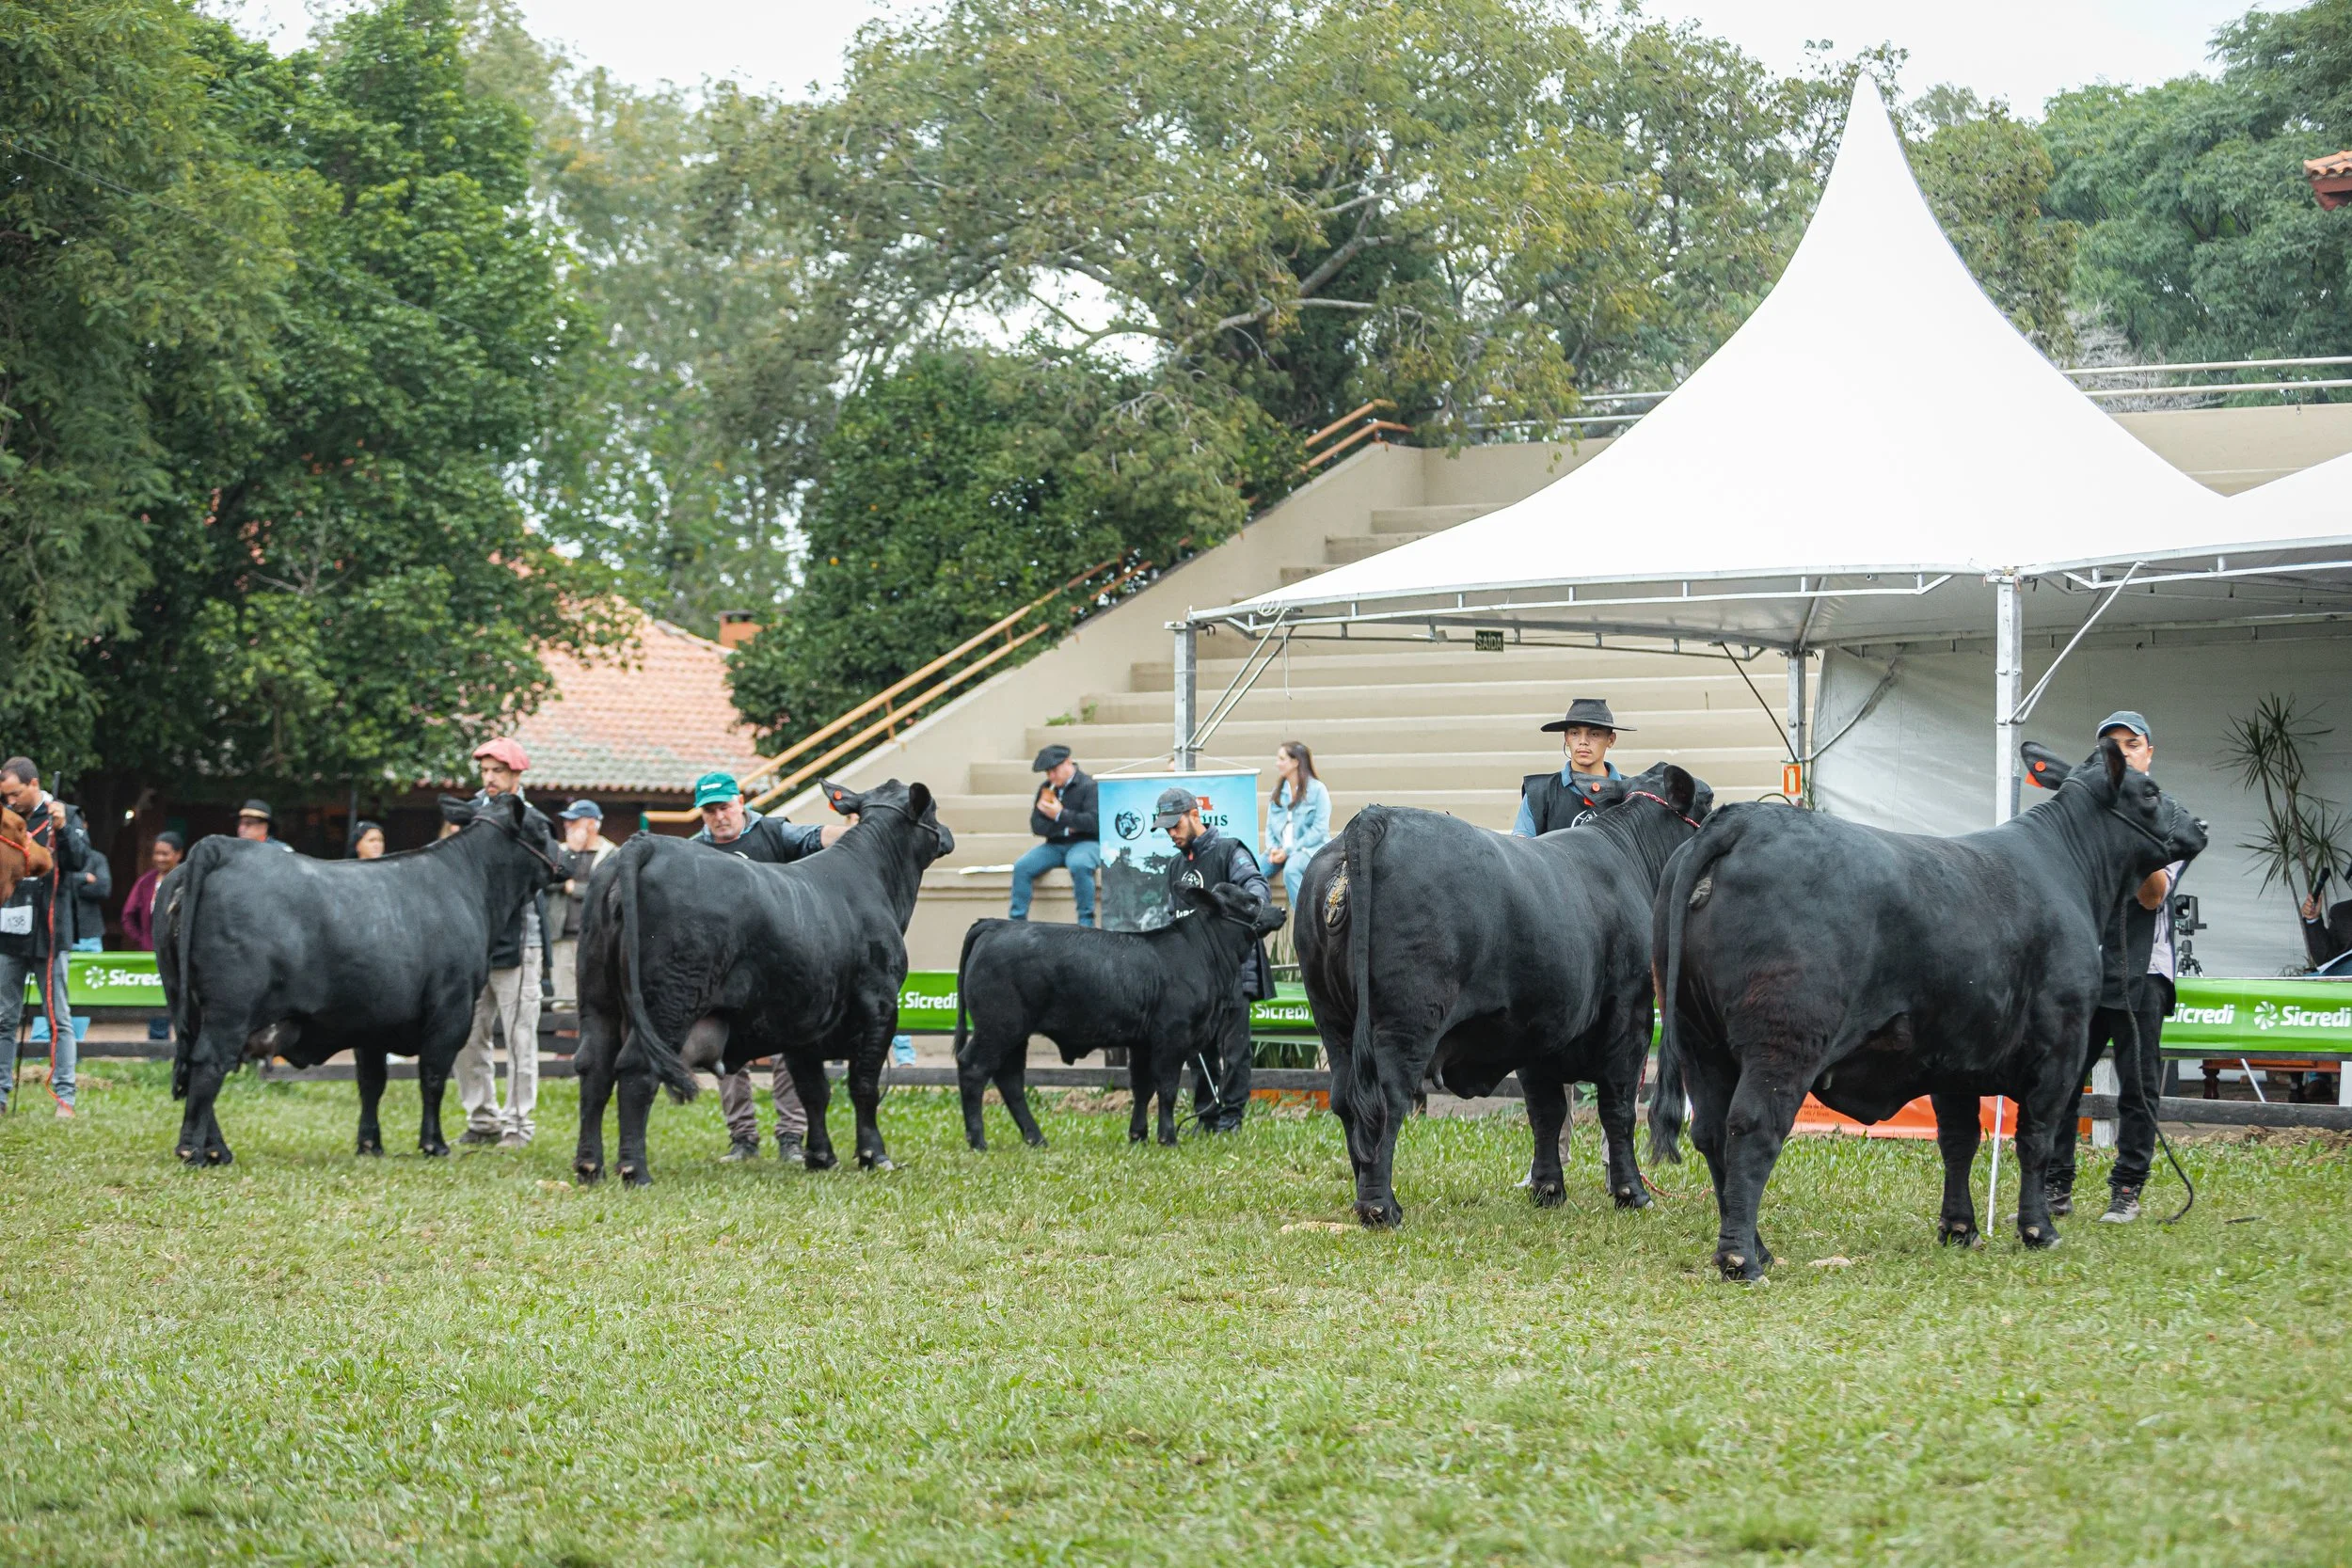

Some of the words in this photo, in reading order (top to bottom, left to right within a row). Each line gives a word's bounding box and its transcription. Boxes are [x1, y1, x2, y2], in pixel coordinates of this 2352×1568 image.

[1477, 632, 1502, 650] SAÍDA
[904, 991, 959, 1008] Sicredi
[1254, 1004, 1310, 1020] Sicredi
[2280, 1006, 2352, 1027] Sicredi
